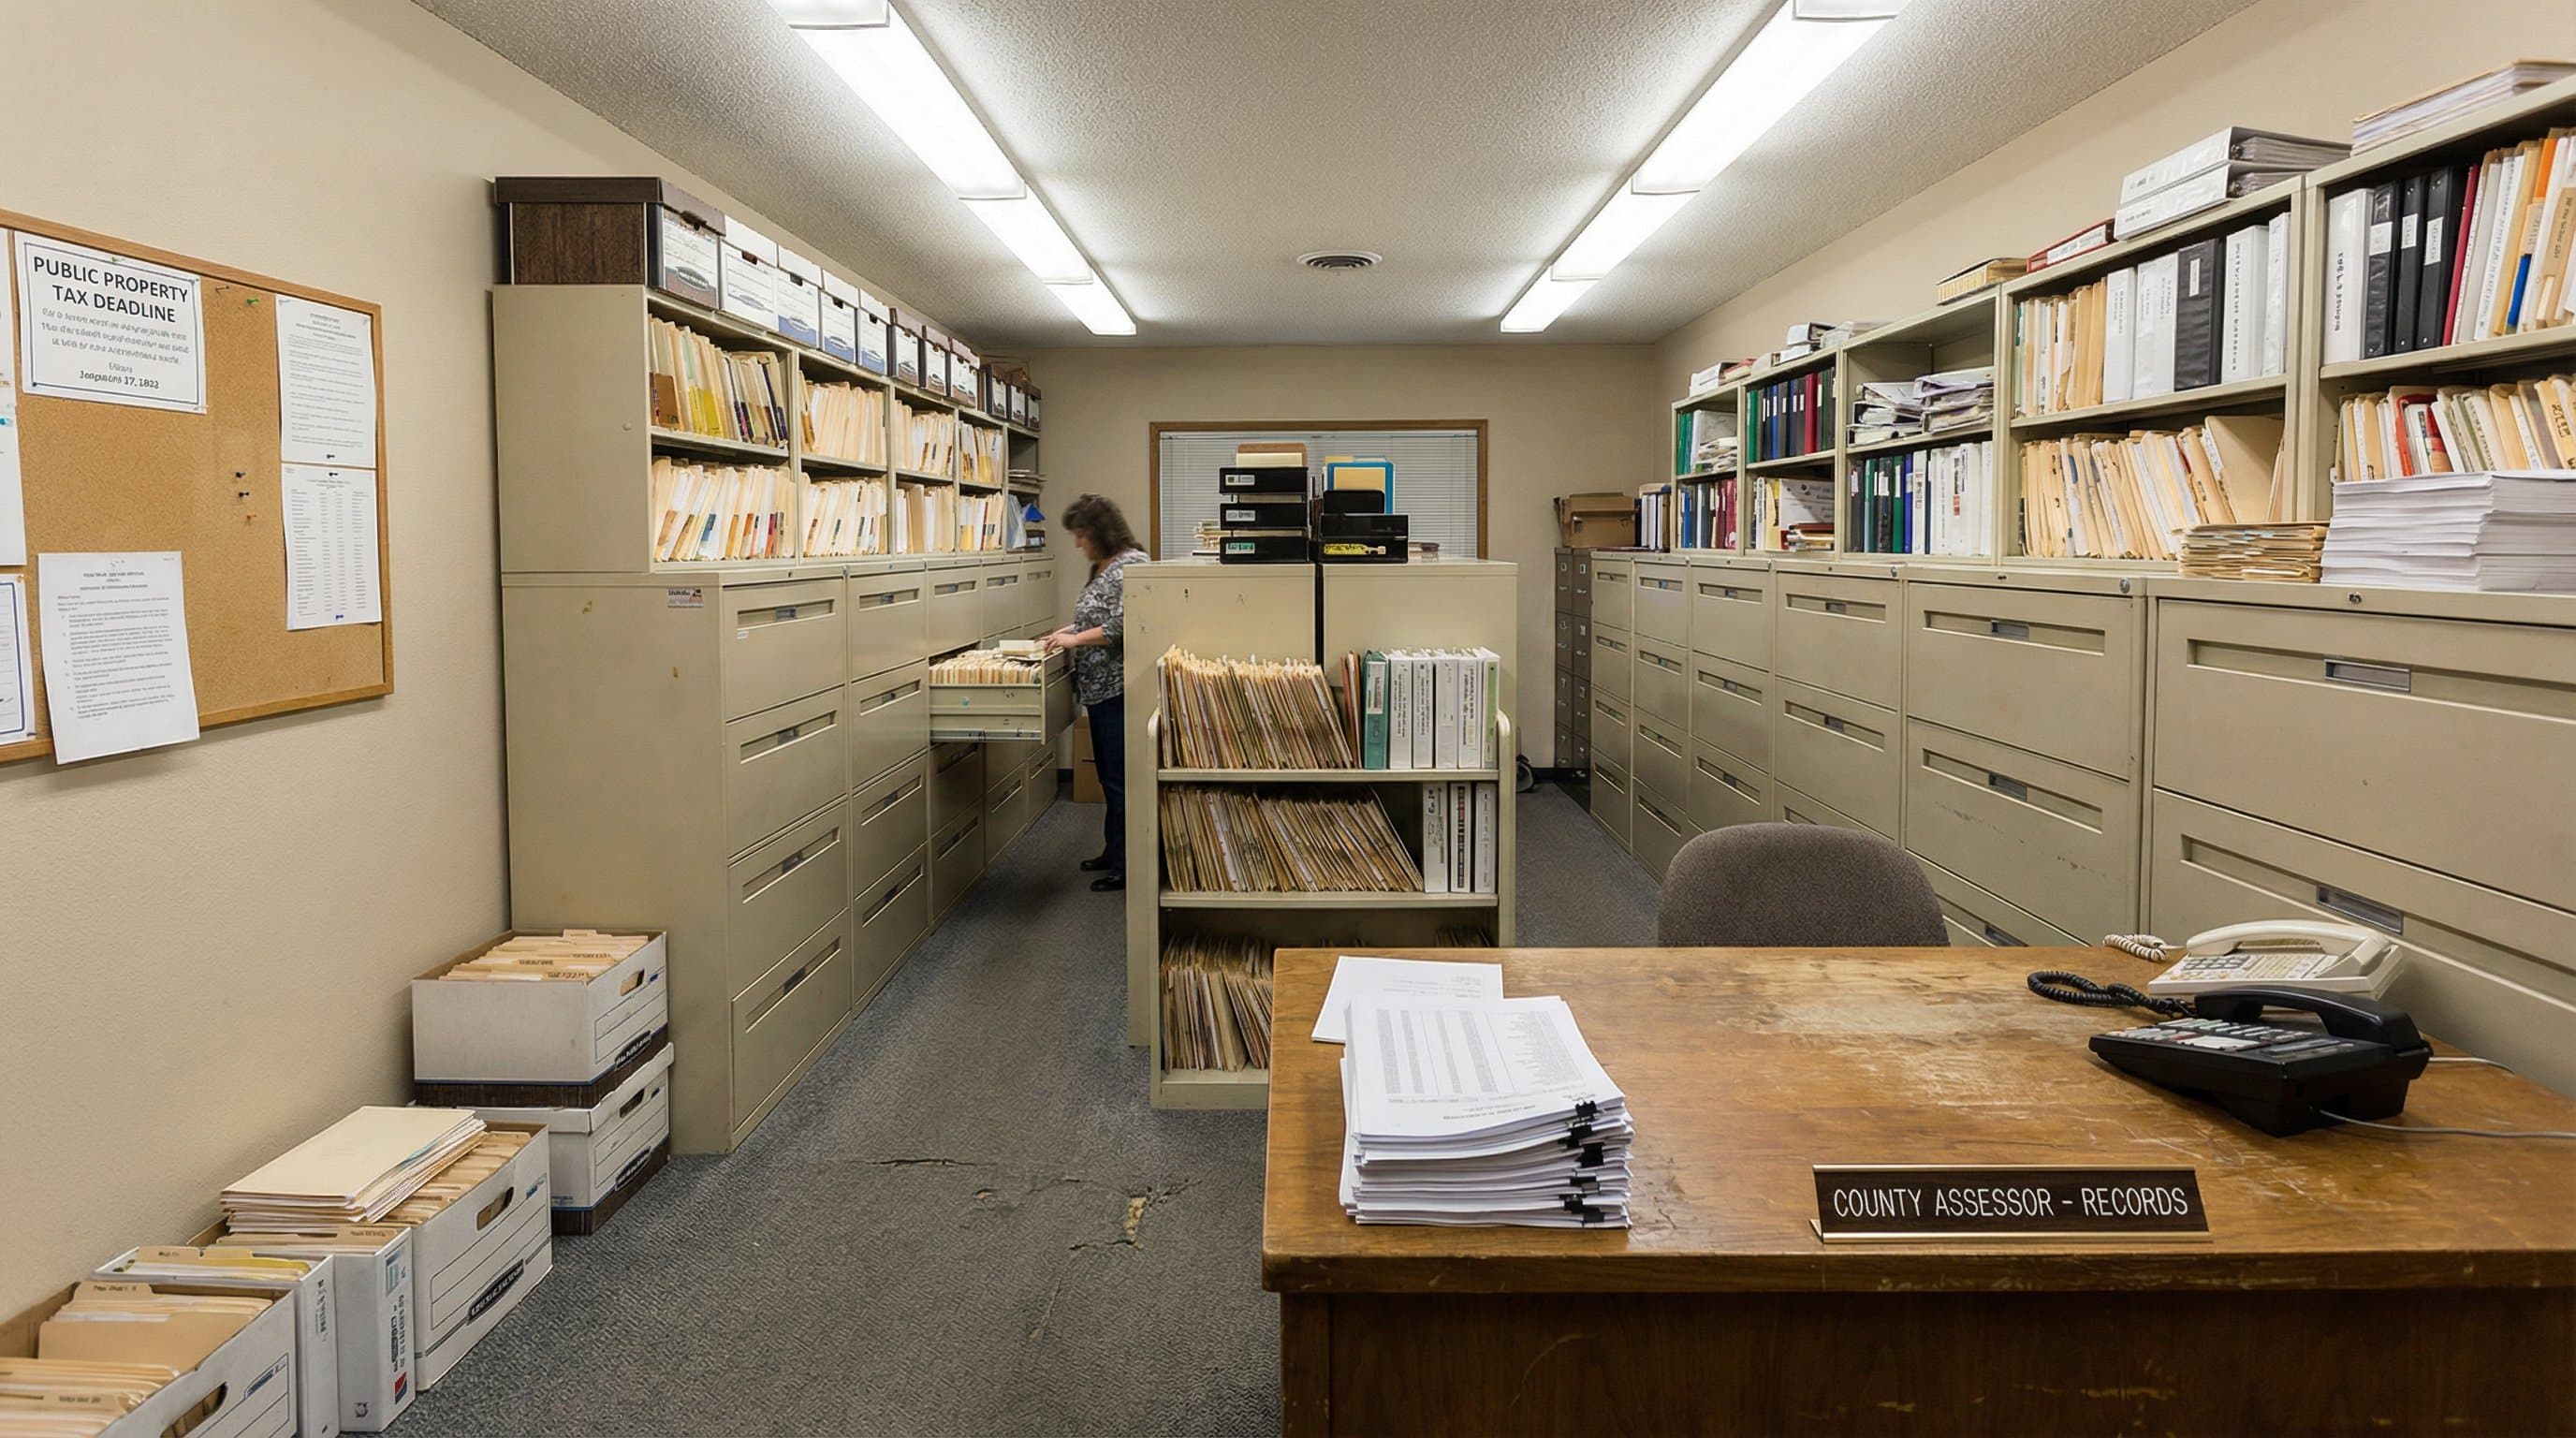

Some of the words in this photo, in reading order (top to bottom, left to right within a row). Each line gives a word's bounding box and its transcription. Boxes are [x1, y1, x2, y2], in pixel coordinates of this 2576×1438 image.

[34, 257, 98, 284] PUBLIC
[104, 272, 188, 302] PROPERTY
[52, 285, 88, 306] TAX
[94, 294, 175, 322] DEADLINE
[1833, 1188, 1922, 1217] COUNTY
[1935, 1188, 2055, 1217] ASSESSOR
[2083, 1187, 2188, 1216] RECORDS
